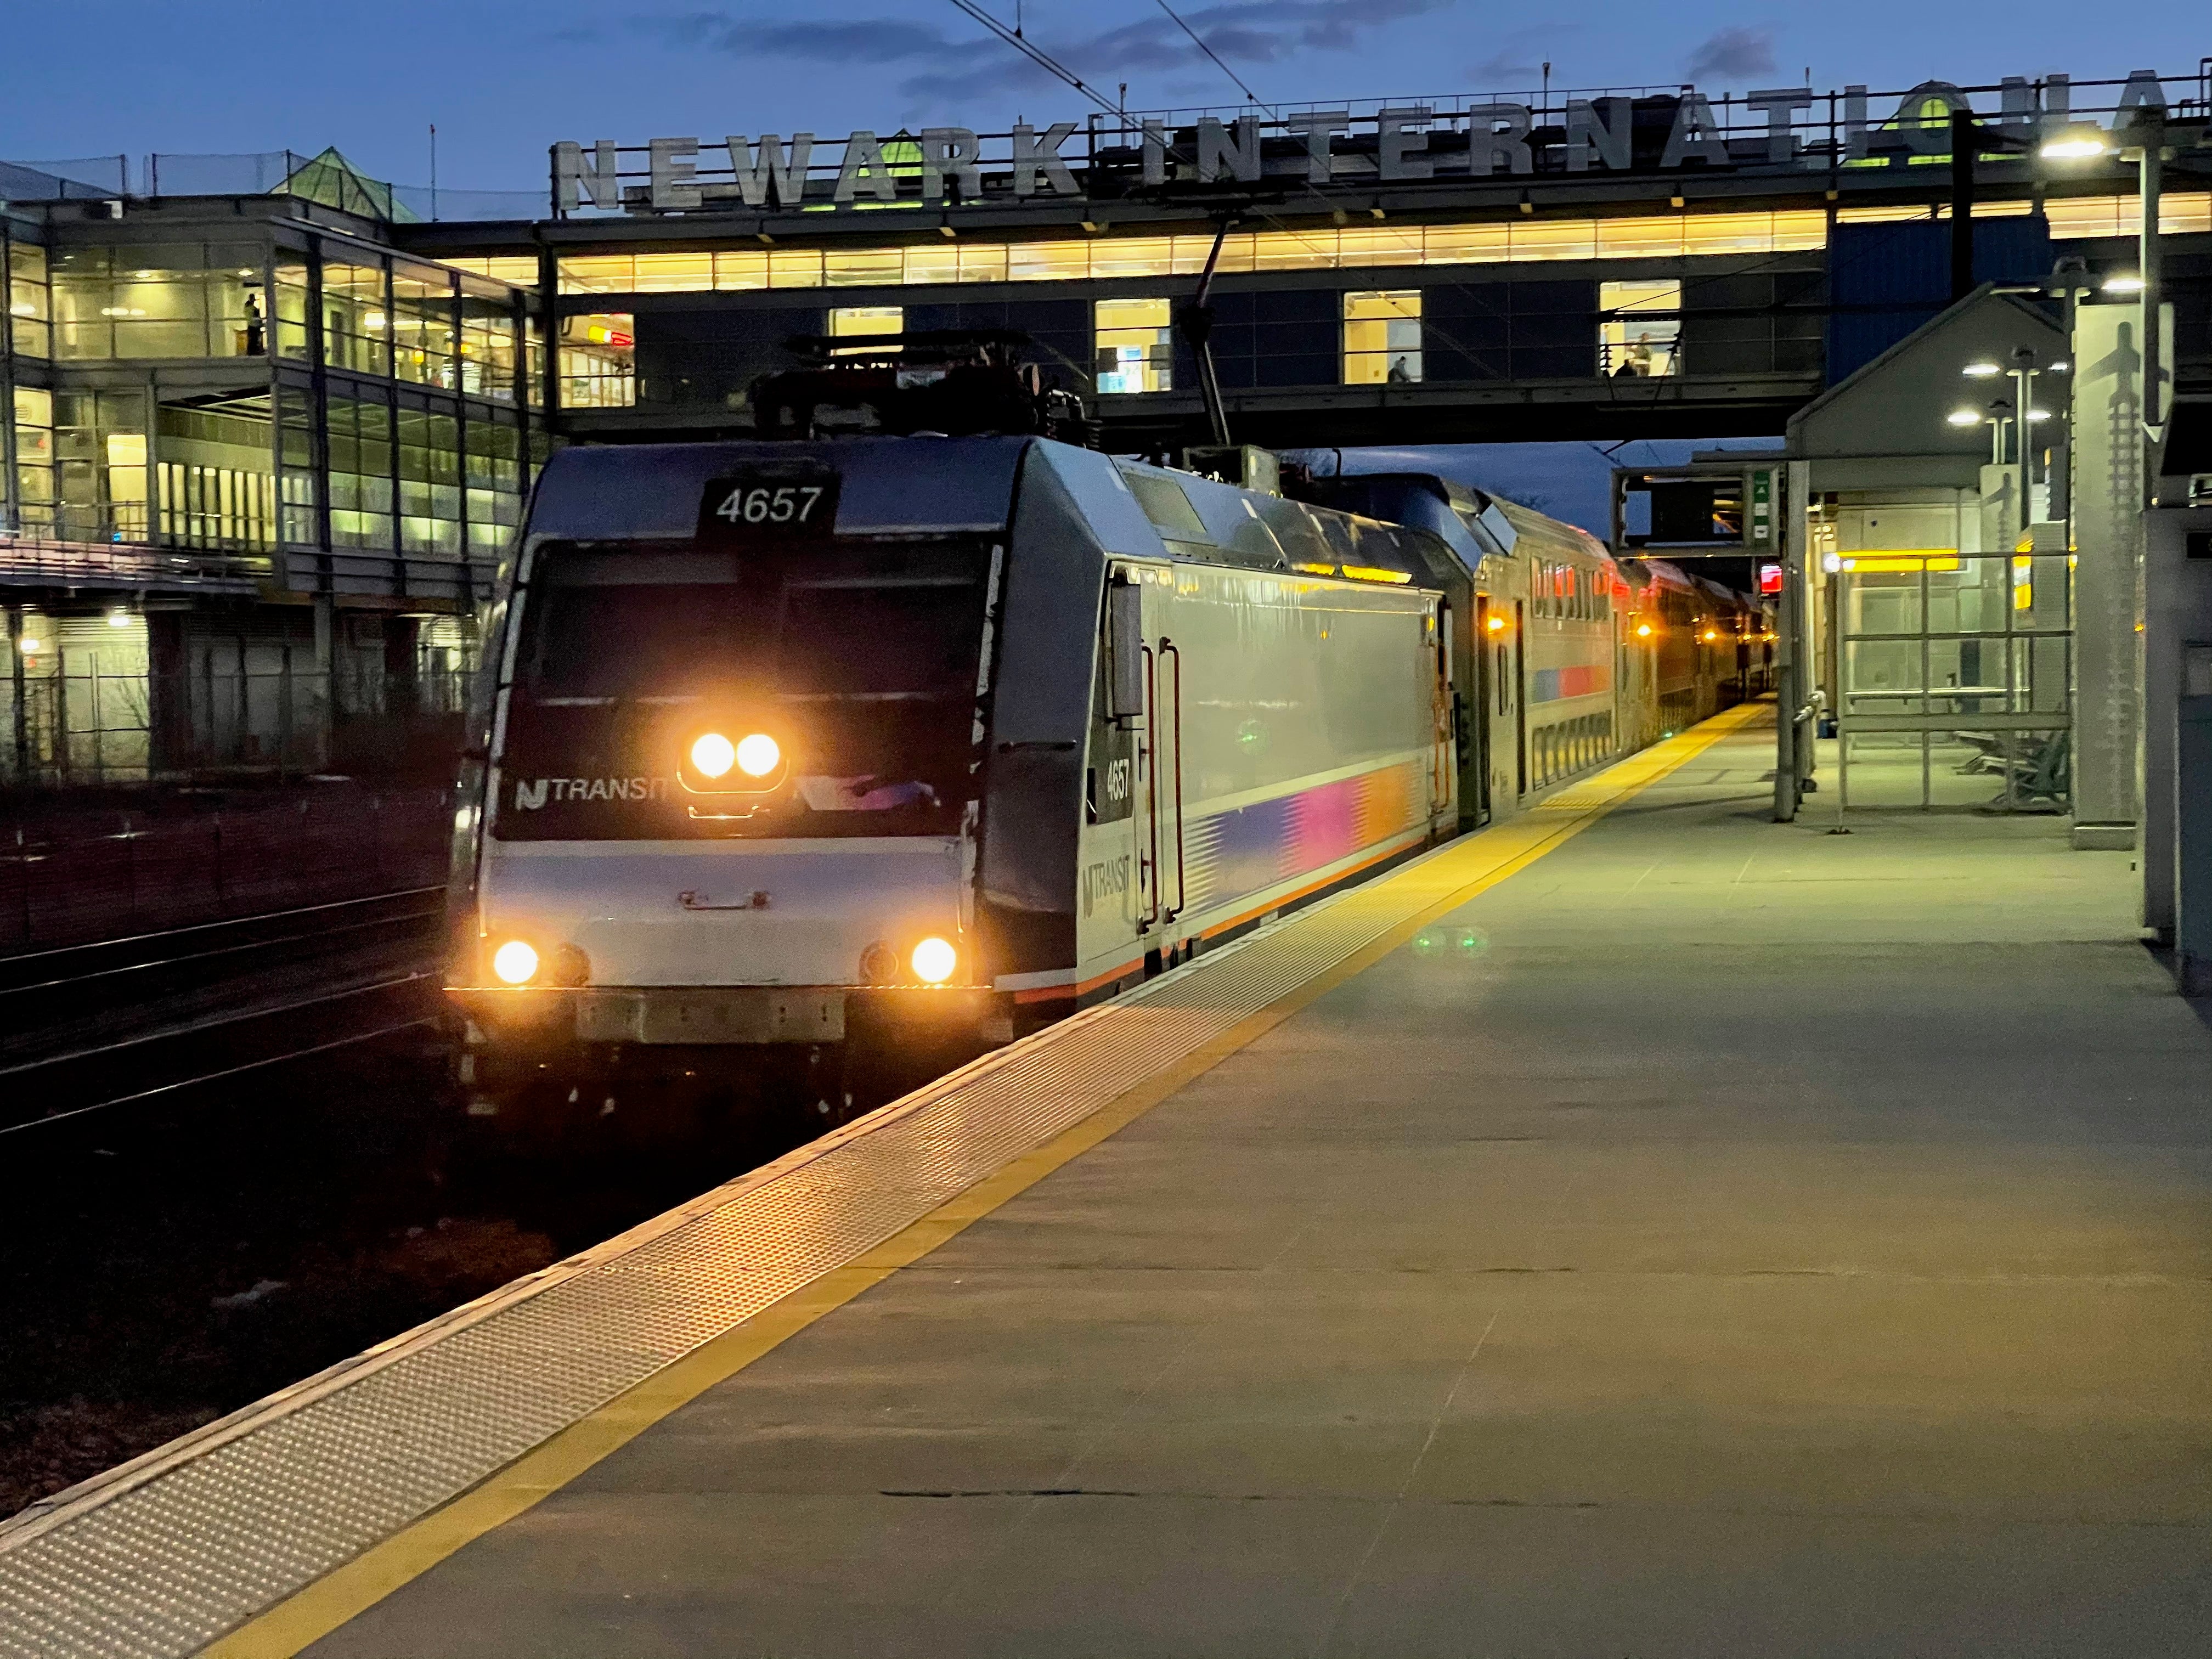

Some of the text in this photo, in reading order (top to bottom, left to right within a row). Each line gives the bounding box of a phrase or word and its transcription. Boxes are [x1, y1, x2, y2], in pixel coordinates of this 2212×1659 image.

[556, 67, 2212, 211] NEWARK INTERNATIONA
[716, 487, 823, 523] 4657
[552, 777, 670, 801] TRANSIT
[1107, 758, 1130, 800] 4657
[1094, 855, 1130, 899] TRANSIT
